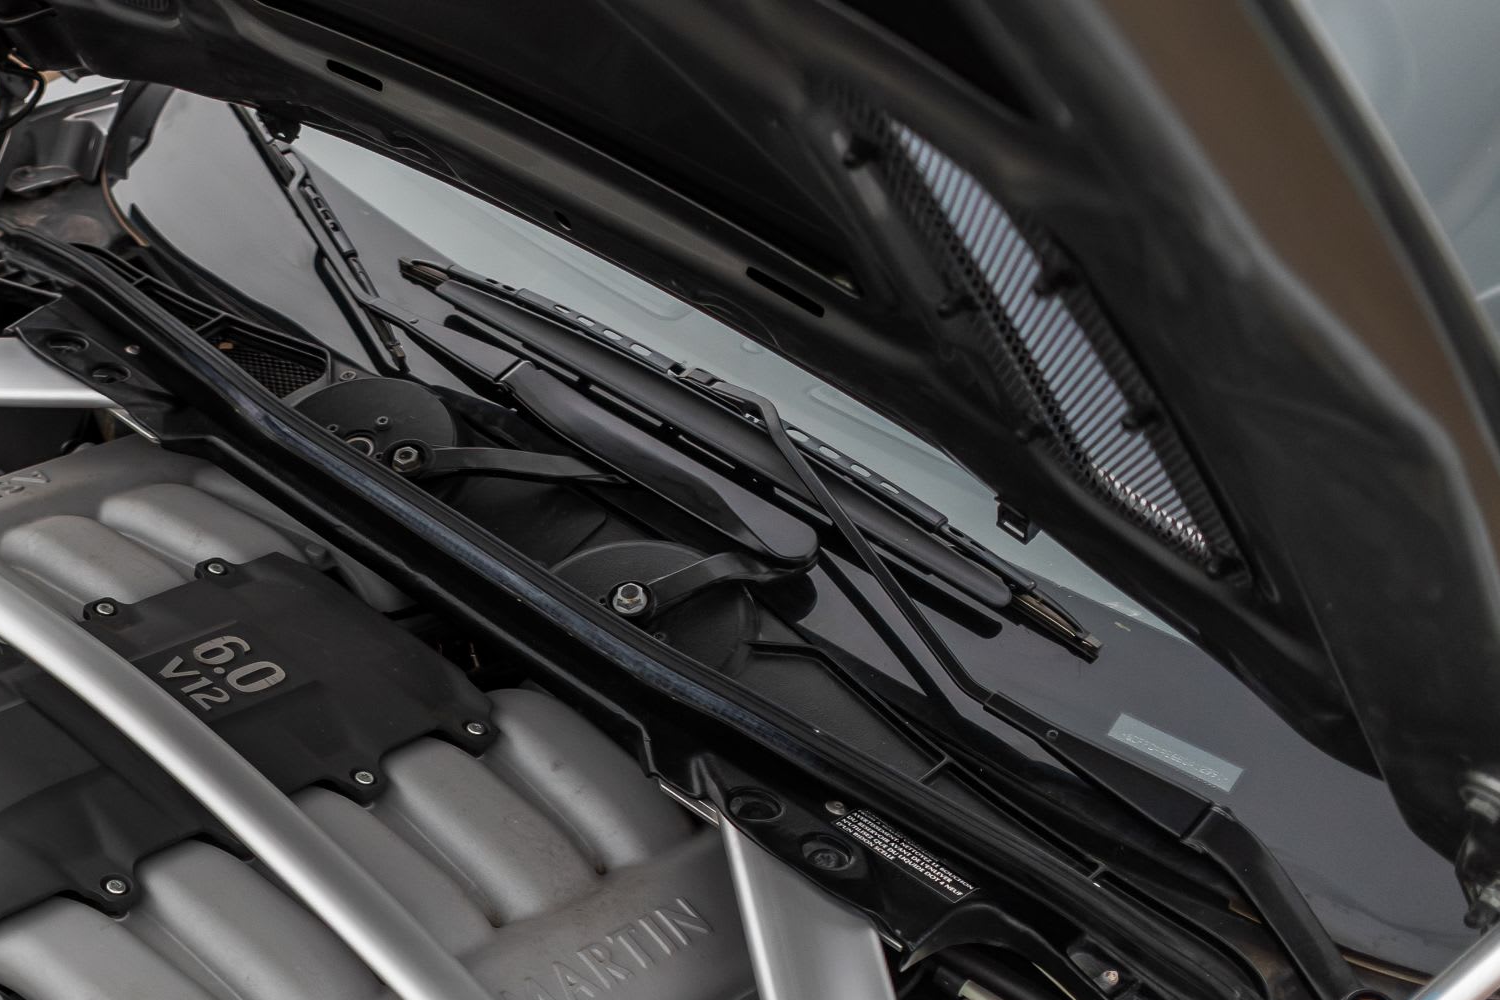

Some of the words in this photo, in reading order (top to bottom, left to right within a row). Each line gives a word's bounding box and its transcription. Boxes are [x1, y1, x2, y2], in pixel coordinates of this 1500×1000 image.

[159, 655, 231, 711] V12
[193, 635, 286, 693] 6.0
[846, 815, 858, 823] DU
[888, 841, 912, 857] AVANT
[852, 831, 874, 846] BIDON
[871, 837, 888, 848] QUE
[886, 847, 899, 855] DU
[896, 853, 926, 873] LIQUIDE
[923, 870, 940, 881] DOT
[943, 883, 963, 896] NEUF
[898, 841, 933, 863] NETTOYEZ
[938, 866, 975, 889] BOUCHON
